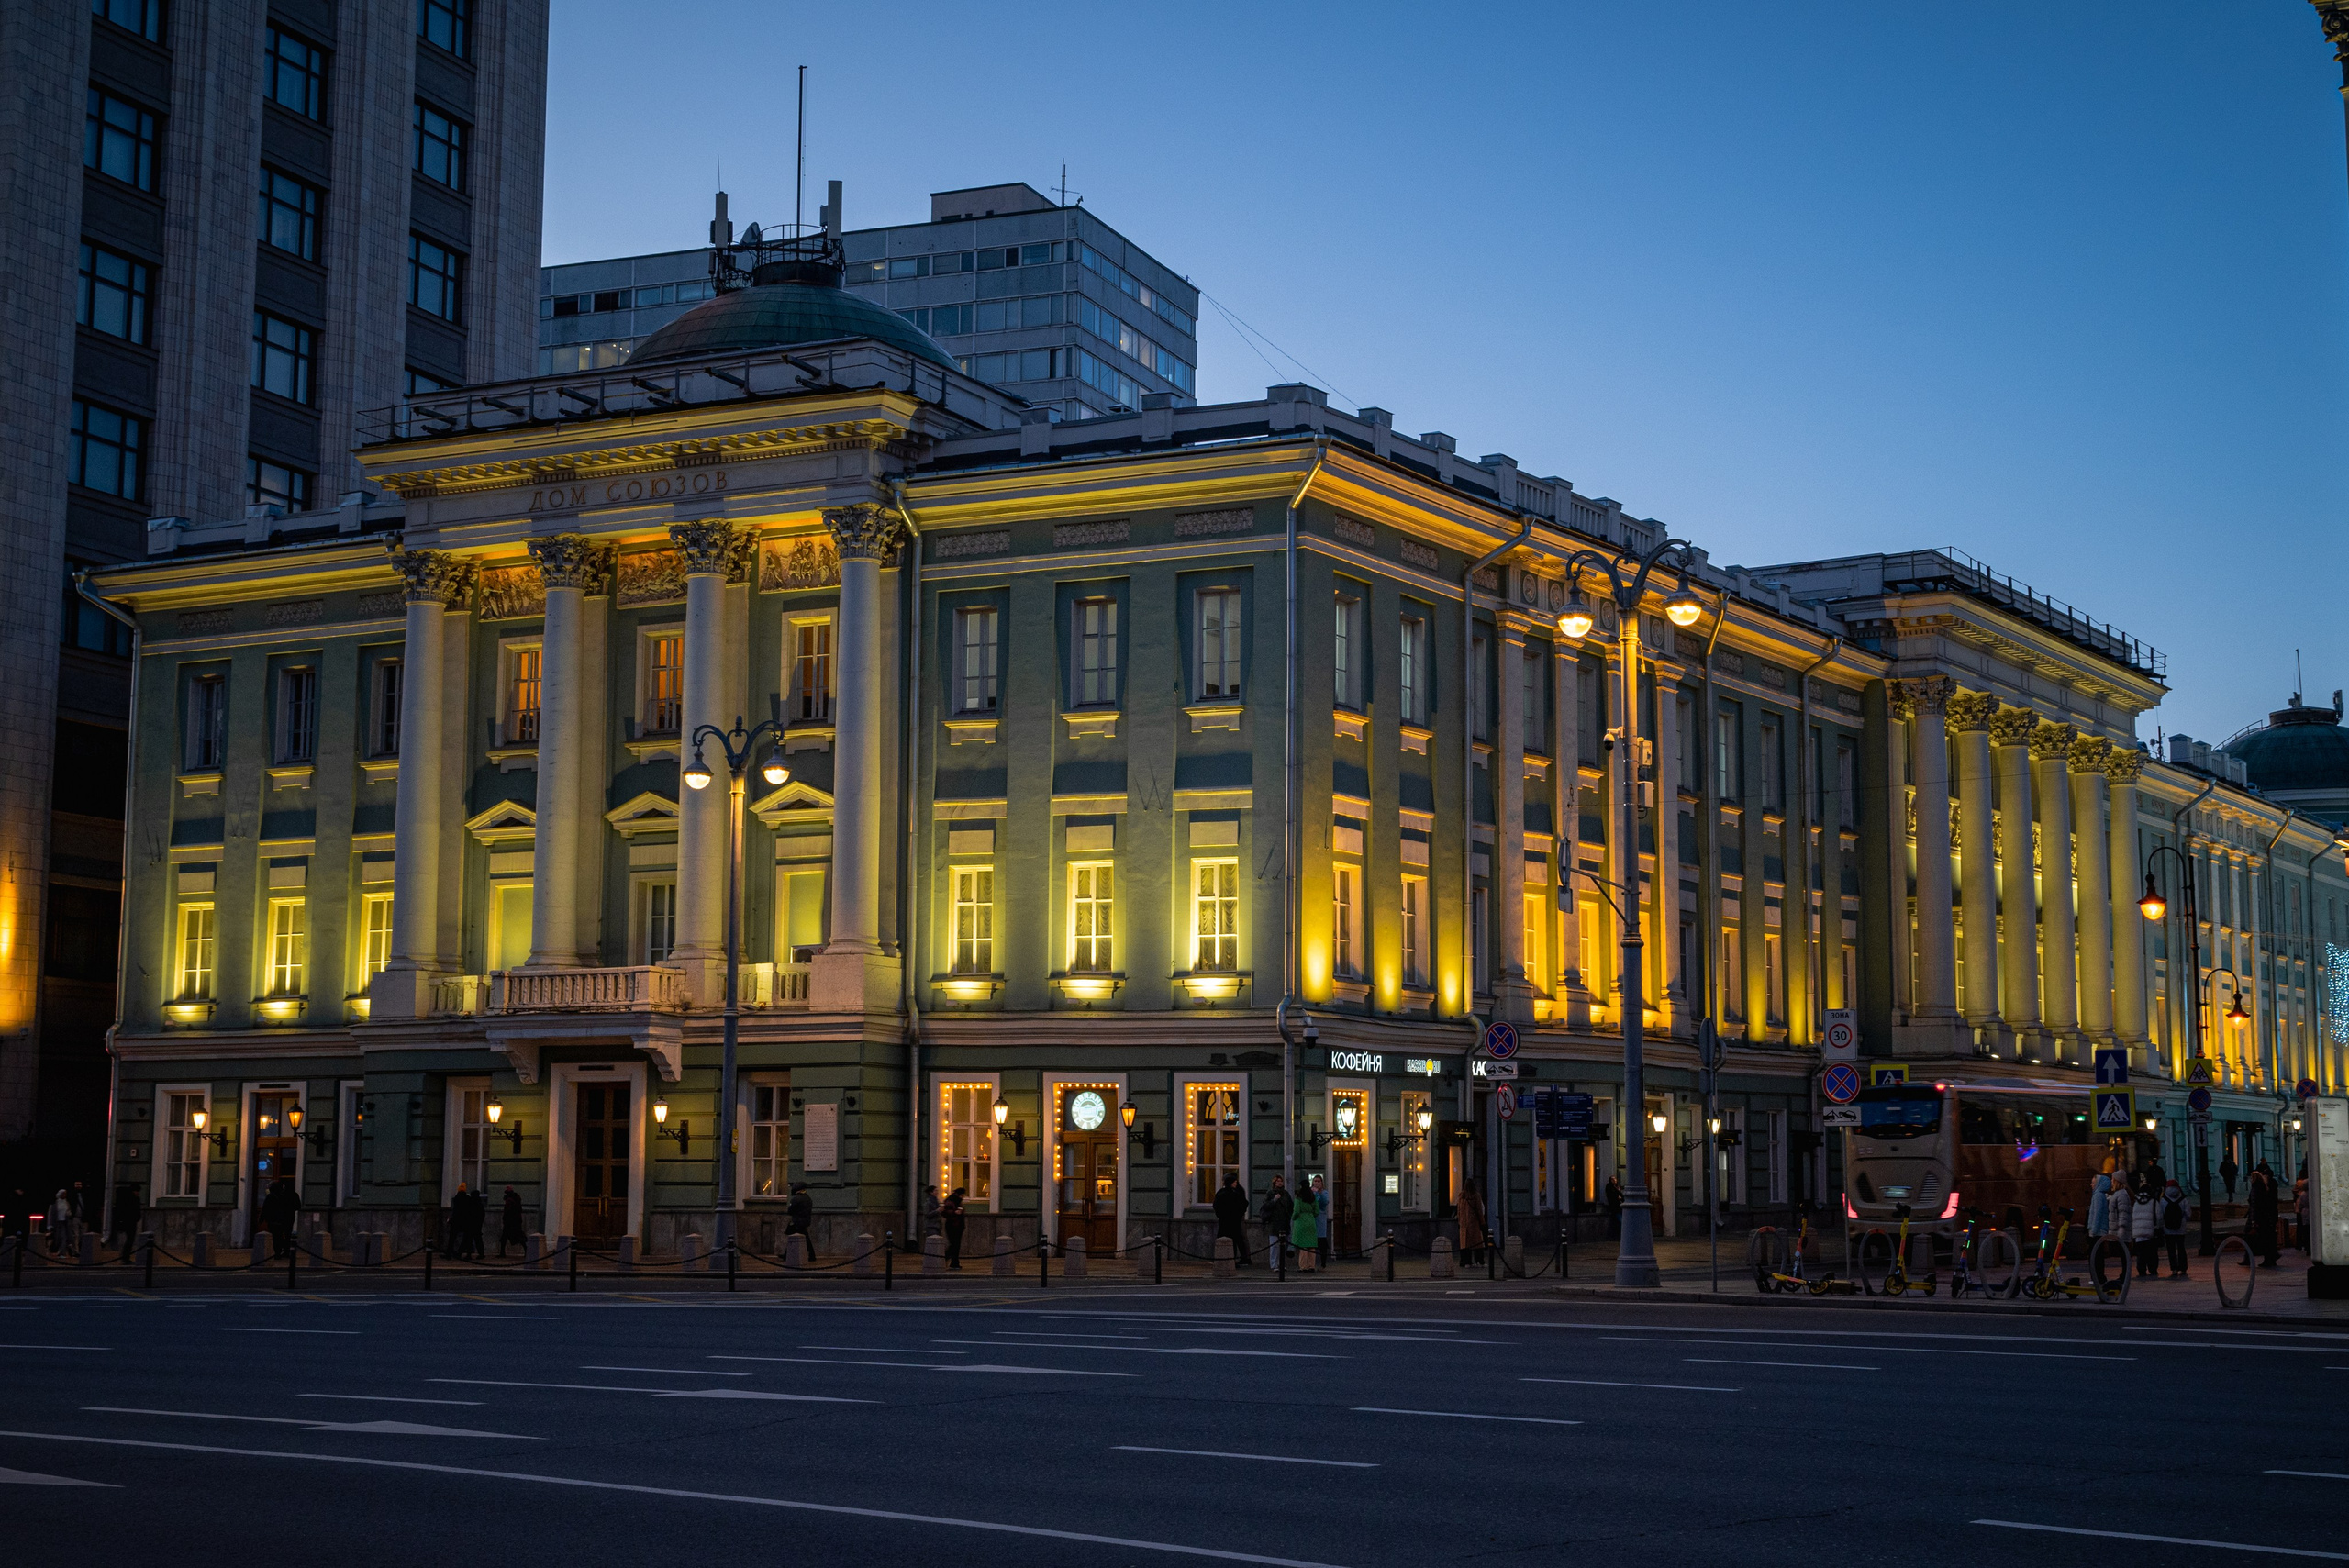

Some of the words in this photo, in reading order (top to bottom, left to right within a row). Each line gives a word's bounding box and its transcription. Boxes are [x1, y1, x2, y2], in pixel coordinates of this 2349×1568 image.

[529, 485, 587, 512] ДОМ
[607, 471, 728, 502] СОЮЗОВ
[1833, 1031, 1847, 1041] 30
[1331, 1051, 1382, 1073] КОФЕЙНЯ
